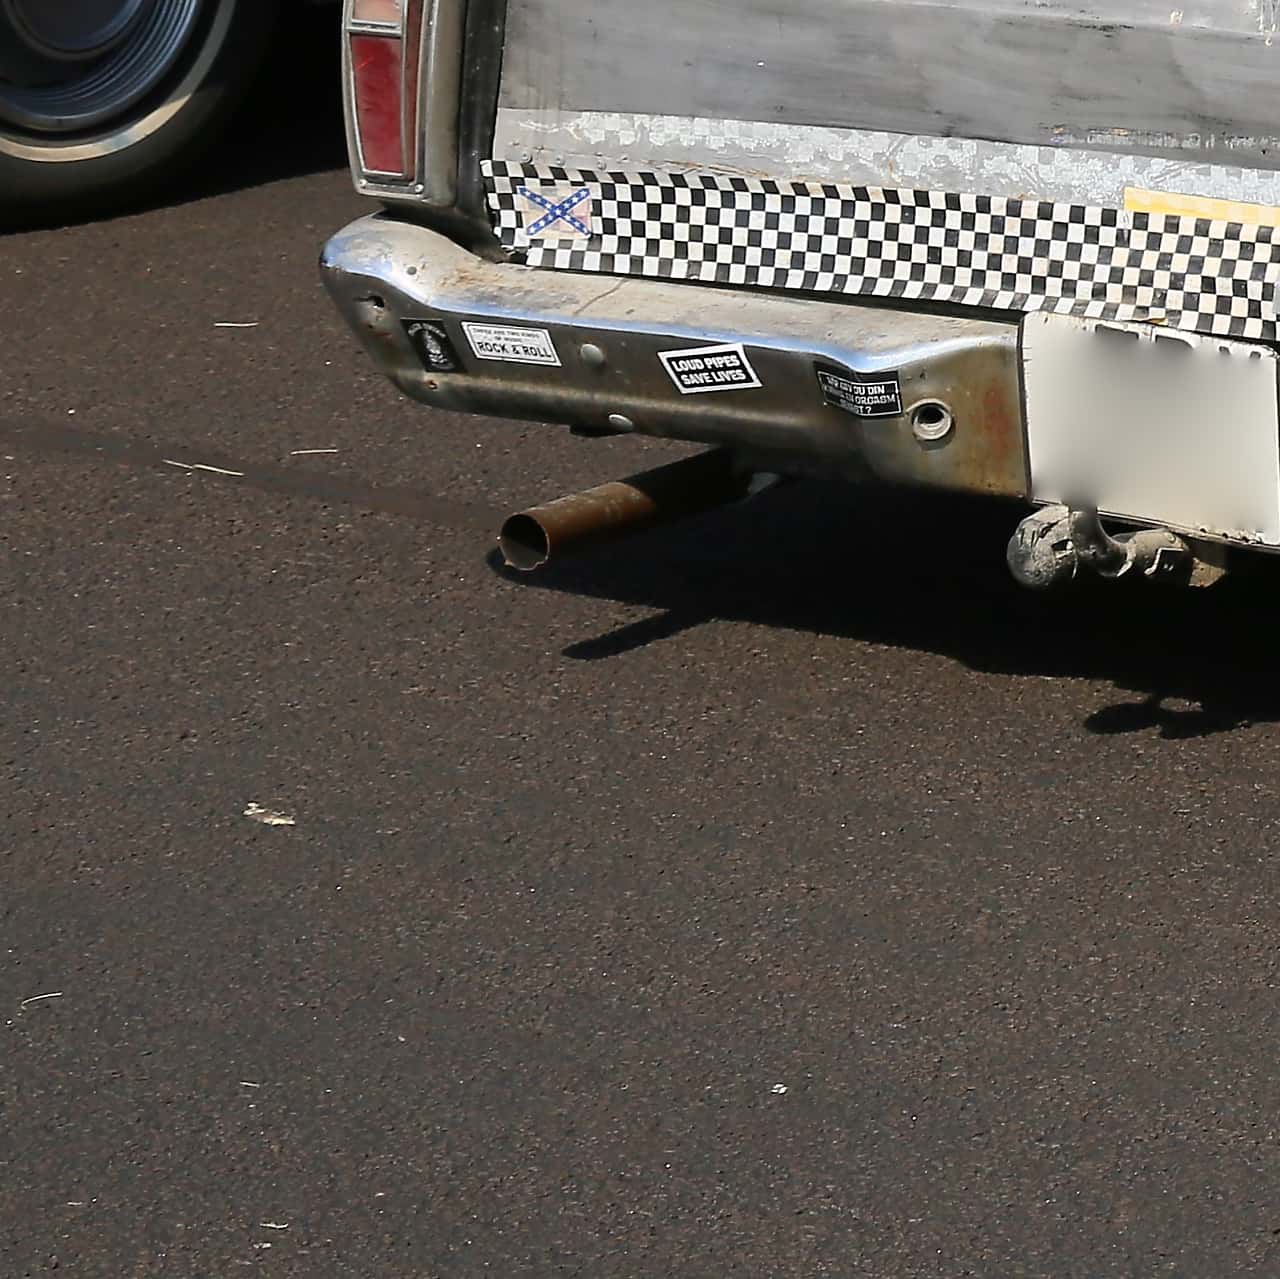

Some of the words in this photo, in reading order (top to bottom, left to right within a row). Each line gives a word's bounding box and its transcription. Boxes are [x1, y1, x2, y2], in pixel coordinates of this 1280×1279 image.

[476, 341, 509, 354] ROCK
[512, 344, 520, 354] &
[522, 345, 551, 358] ROLL
[672, 358, 704, 372] LOUD
[706, 355, 741, 369] PIPES
[680, 371, 711, 386] SAVE
[711, 369, 747, 383] LIVES
[853, 385, 866, 395] DU
[867, 385, 885, 395] DIN
[854, 393, 896, 405] ORGASM
